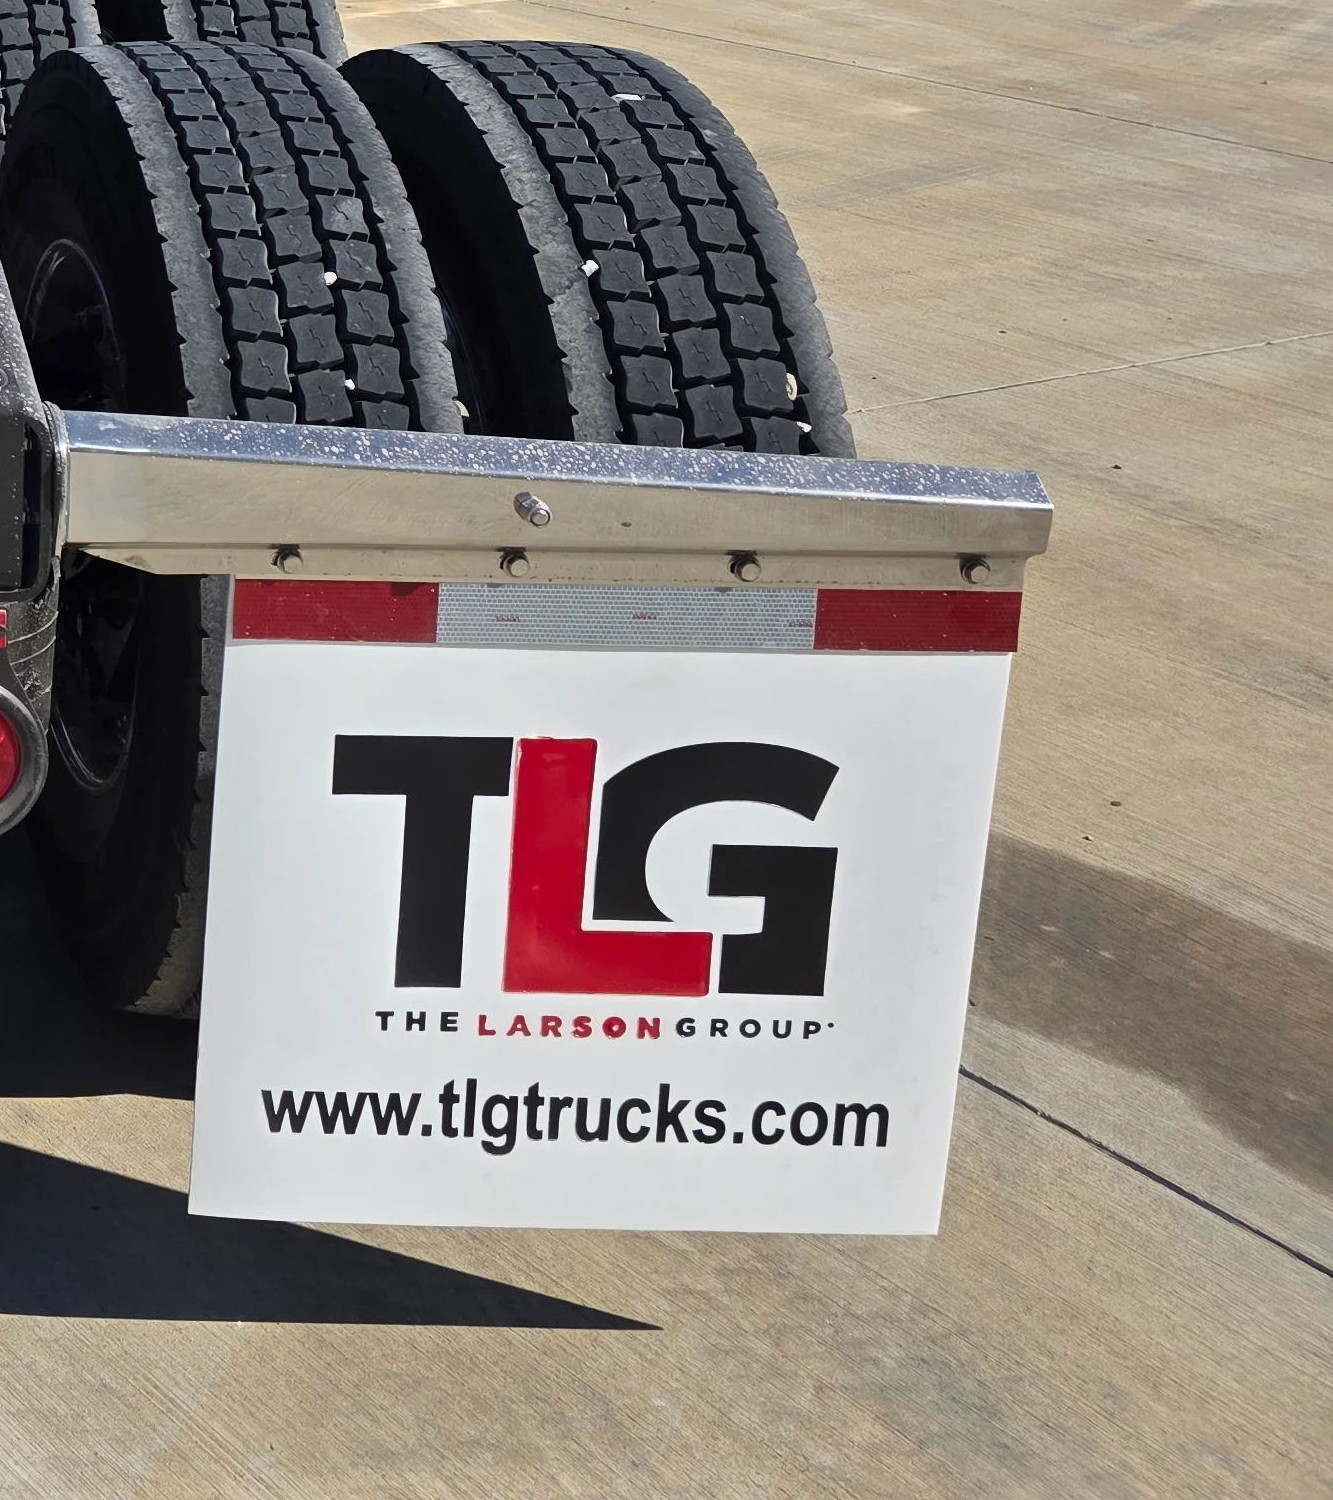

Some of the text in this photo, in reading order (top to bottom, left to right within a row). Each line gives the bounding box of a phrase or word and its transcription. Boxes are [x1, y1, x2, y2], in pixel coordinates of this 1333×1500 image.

[331, 734, 840, 998] TLG
[375, 1011, 822, 1040] THE LARSON GROUP
[260, 1077, 890, 1156] www.tlgtrucks.com
